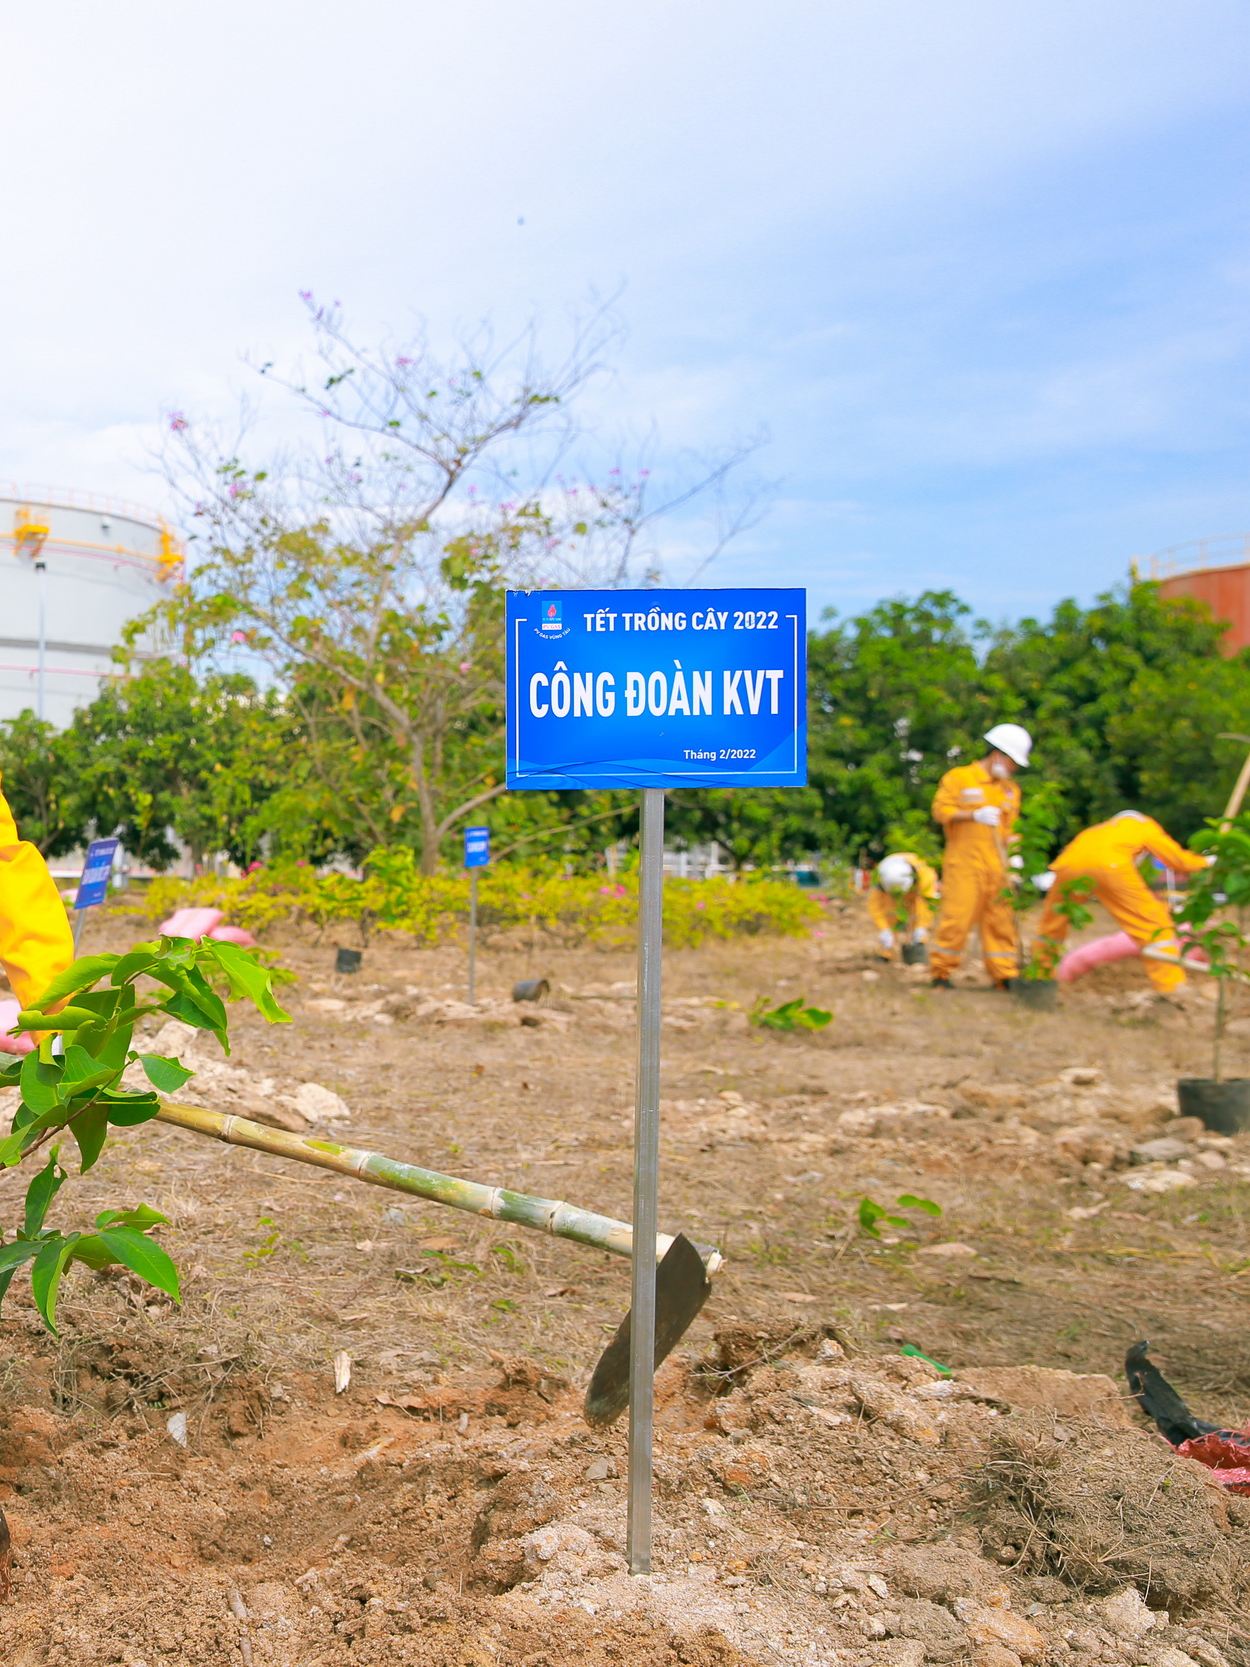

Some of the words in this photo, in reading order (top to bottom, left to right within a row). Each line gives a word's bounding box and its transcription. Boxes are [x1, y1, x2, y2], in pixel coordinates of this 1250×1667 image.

[583, 607, 617, 632] TẾT
[622, 606, 687, 632] TRỒNG
[692, 607, 728, 630] CÂY
[733, 611, 779, 630] 2022
[529, 660, 616, 719] CÔNG
[624, 659, 713, 717] ĐOÀN
[723, 669, 784, 715] KVT
[683, 749, 717, 762] Tháng
[719, 748, 756, 760] 2/2022
